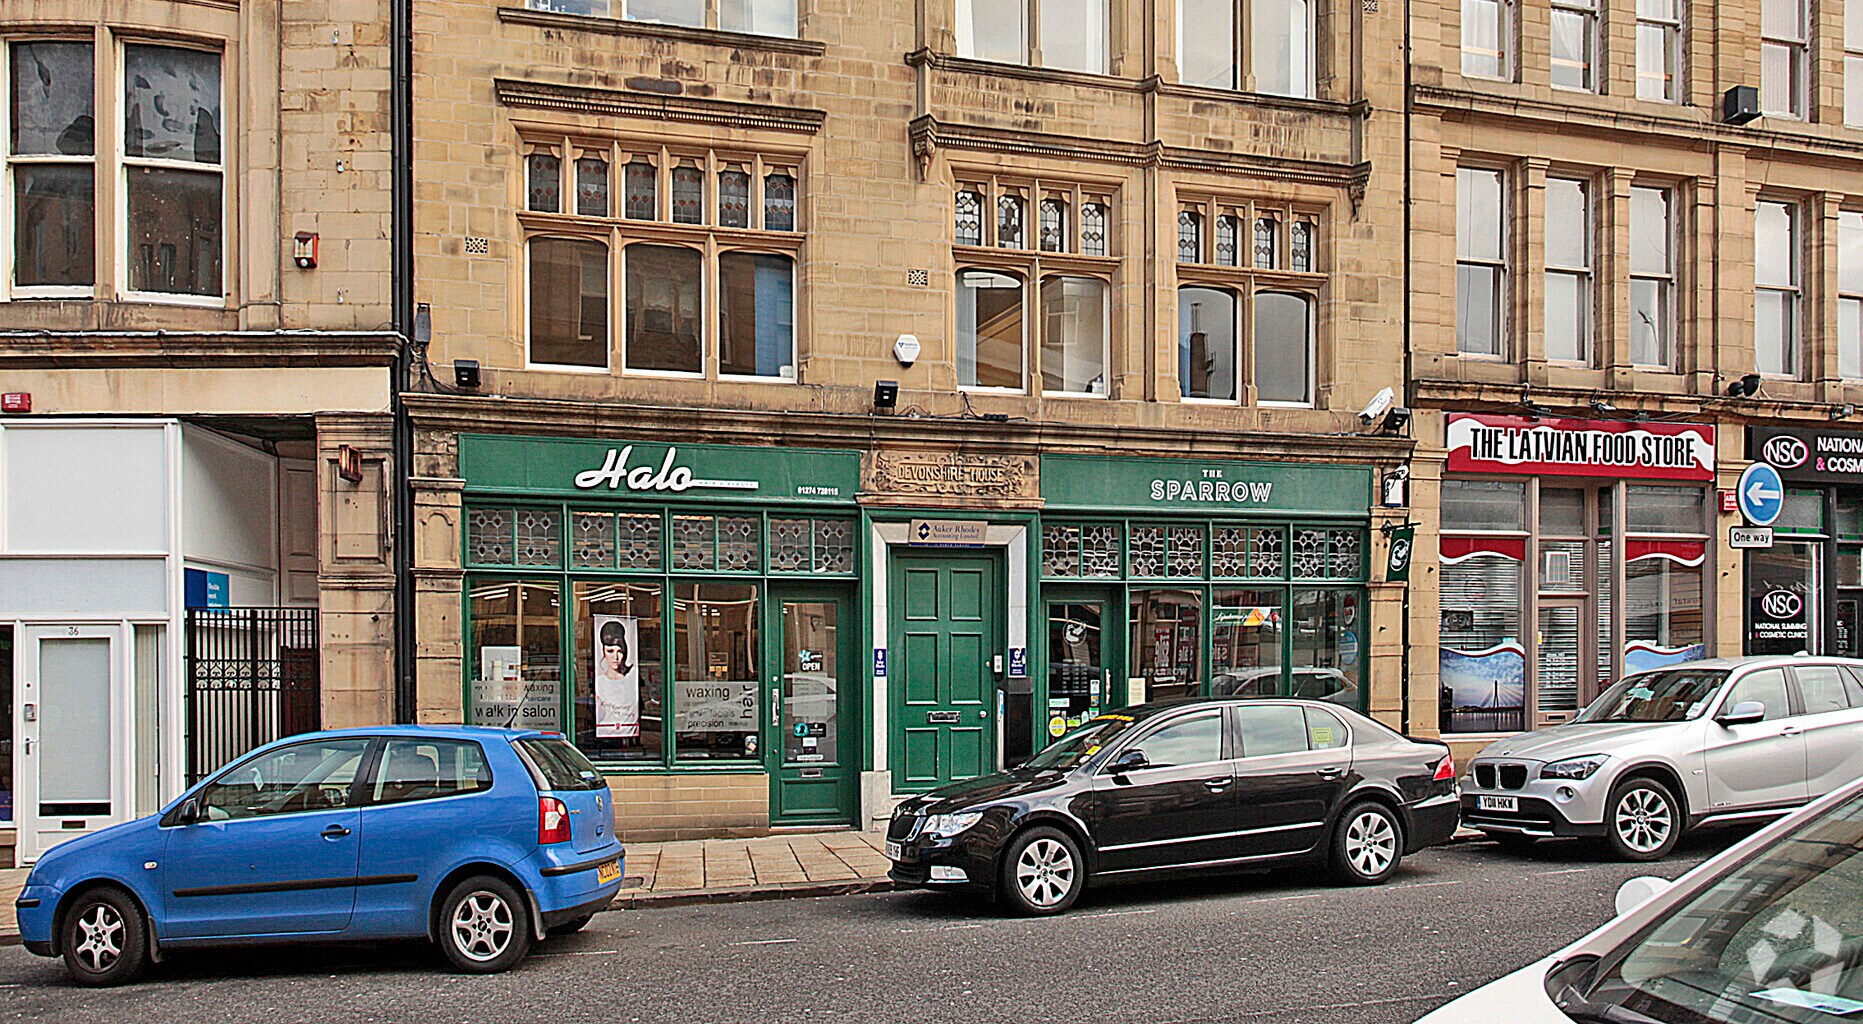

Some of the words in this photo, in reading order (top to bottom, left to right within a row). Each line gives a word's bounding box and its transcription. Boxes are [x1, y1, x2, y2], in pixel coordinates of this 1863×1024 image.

[1471, 428, 1503, 458] THE
[1508, 430, 1588, 462] LATVIAN
[1593, 434, 1636, 464] FOOD
[1641, 436, 1696, 466] STORE
[575, 445, 692, 491] Halo
[1816, 457, 1826, 472] &
[898, 465, 964, 482] DEVONSHIRE
[970, 467, 1004, 483] HOUSE
[1202, 469, 1222, 478] THE
[1151, 479, 1273, 503] SPARROW
[1733, 532, 1751, 542] One
[1753, 533, 1770, 544] way
[68, 626, 79, 636] 36
[1755, 622, 1781, 630] NATIONAL
[802, 662, 821, 671] OPEN
[686, 685, 730, 701] waxing
[740, 685, 754, 719] hair
[475, 704, 504, 717] walk
[507, 704, 519, 717] in
[522, 704, 556, 718] salon
[687, 719, 725, 729] precision
